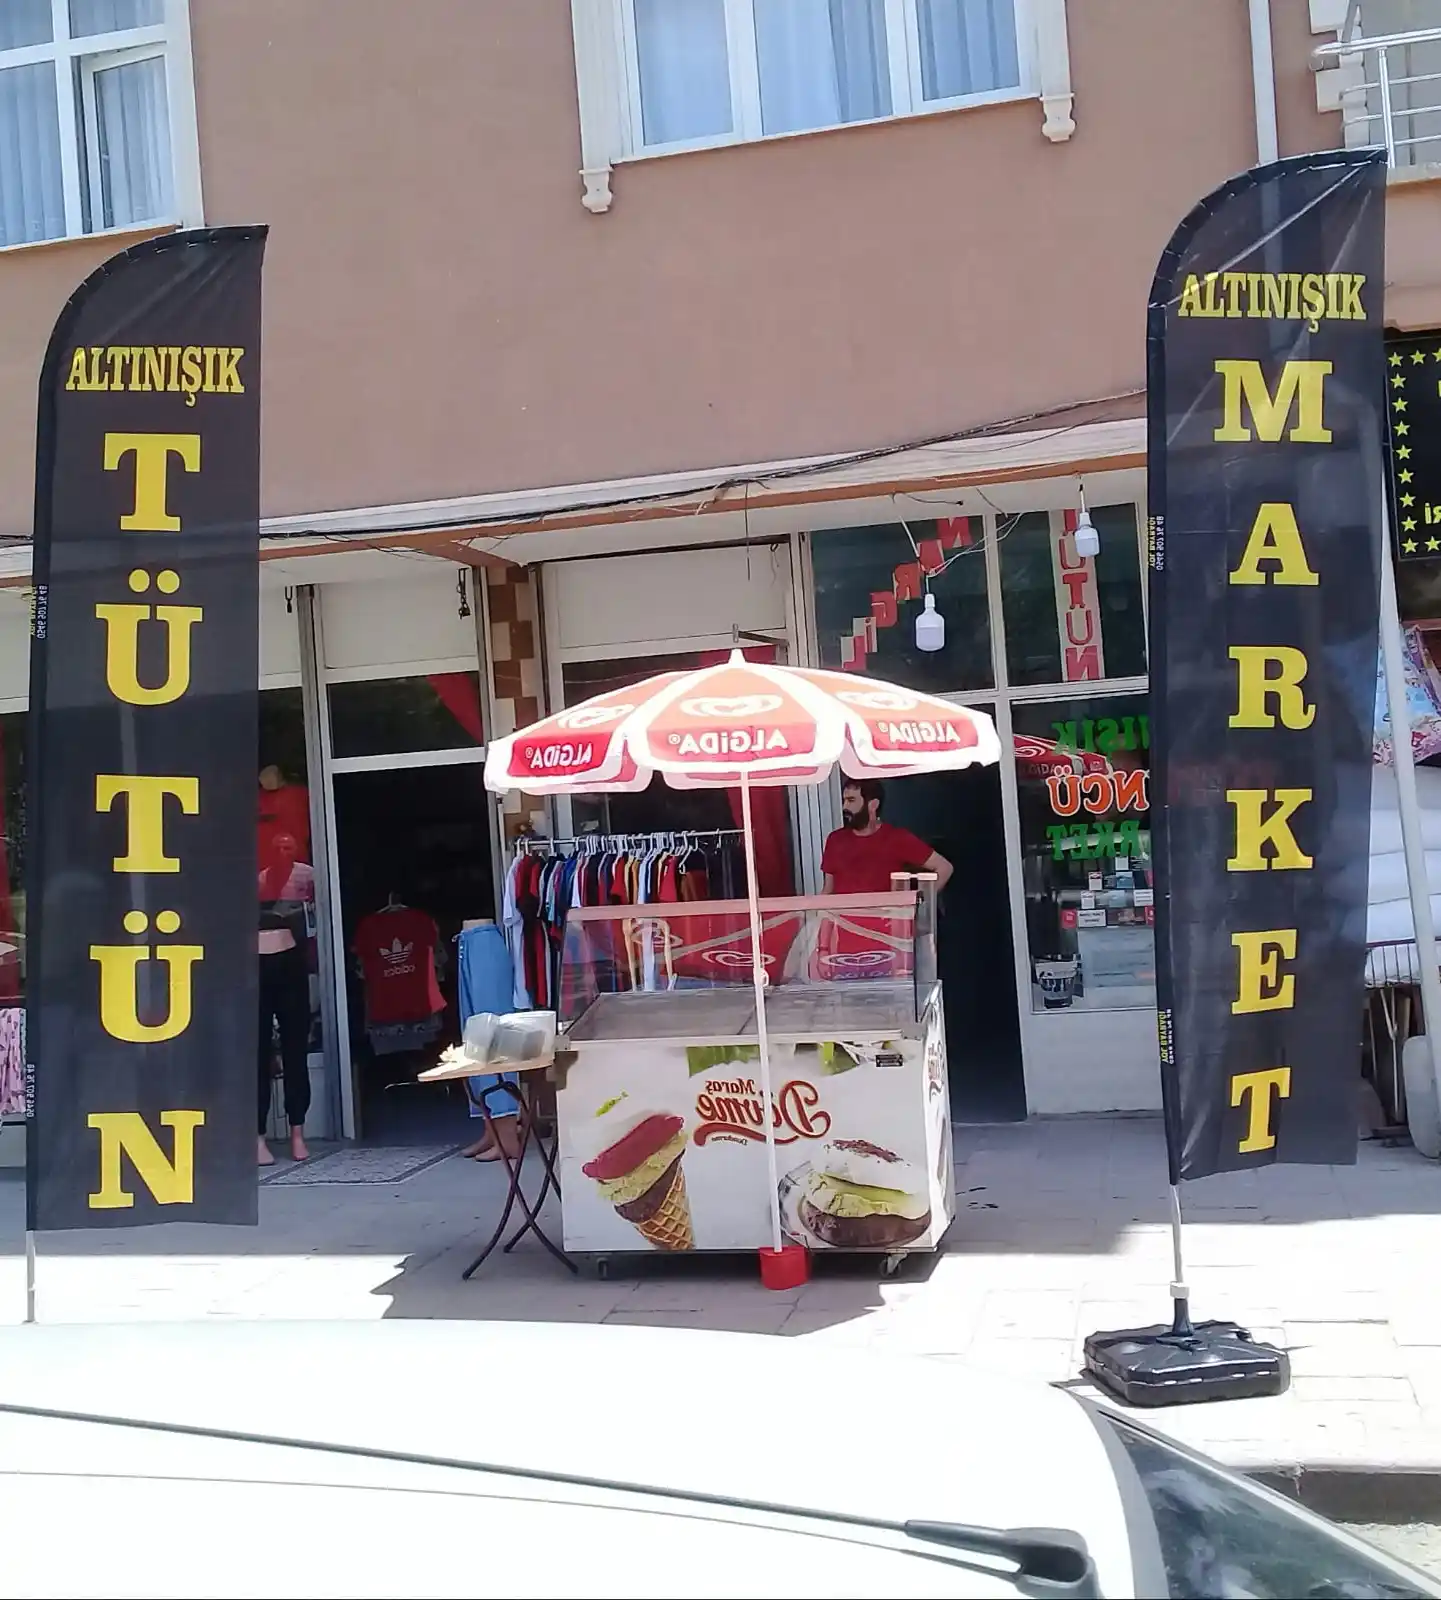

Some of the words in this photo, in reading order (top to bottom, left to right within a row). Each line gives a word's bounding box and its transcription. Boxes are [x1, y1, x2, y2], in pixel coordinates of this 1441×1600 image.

[64, 345, 246, 408] ALTINIŞIK
[1177, 271, 1368, 334] ALTINIŞIK
[87, 431, 204, 1210] TÜTÜN
[1212, 359, 1334, 1156] MARKET
